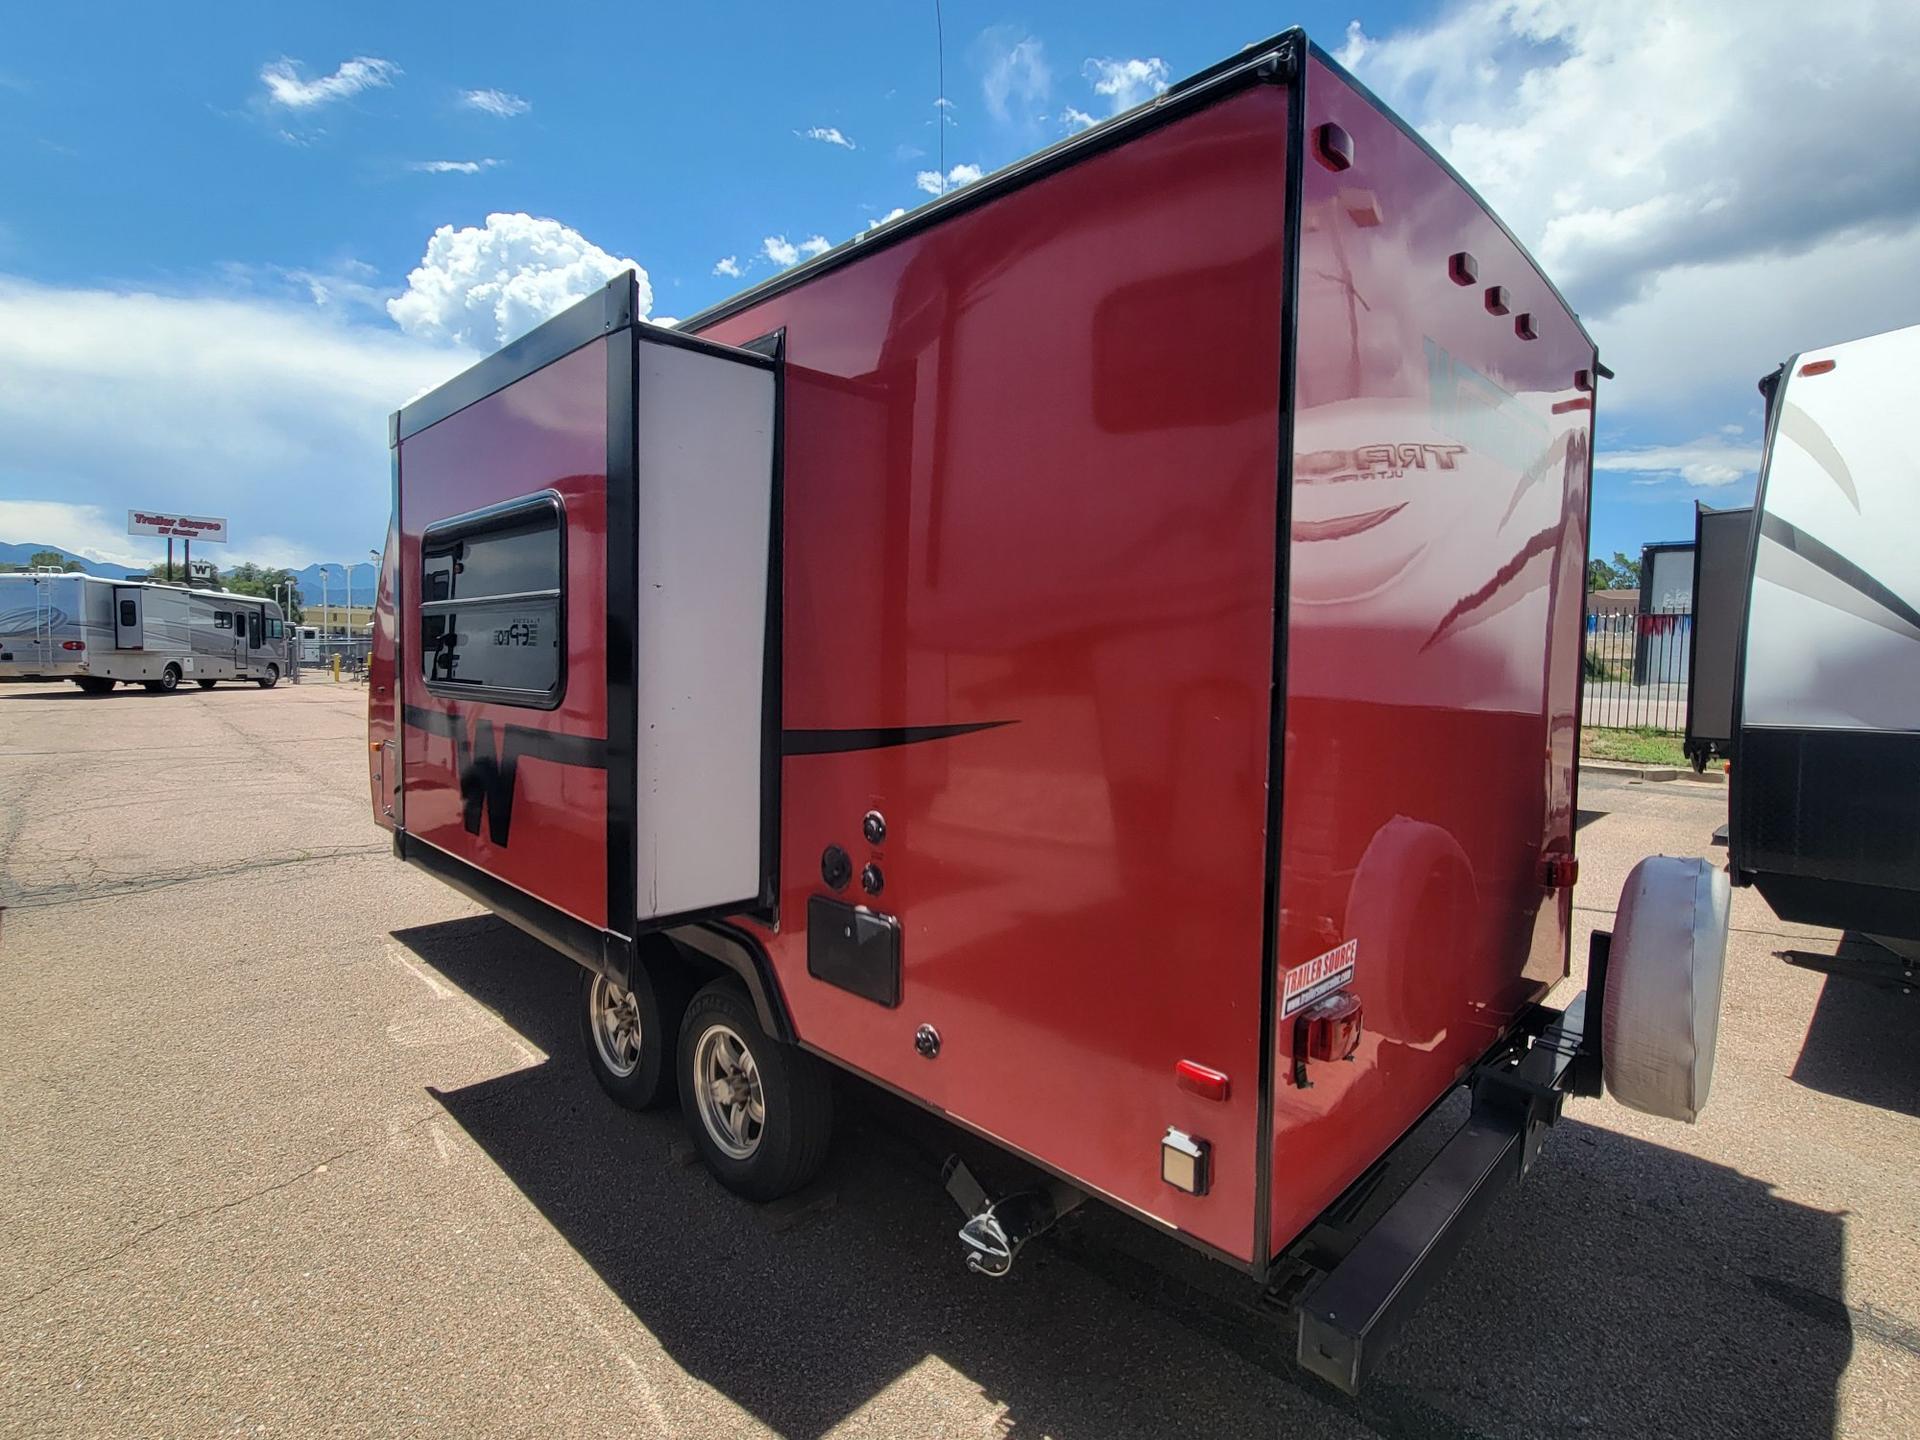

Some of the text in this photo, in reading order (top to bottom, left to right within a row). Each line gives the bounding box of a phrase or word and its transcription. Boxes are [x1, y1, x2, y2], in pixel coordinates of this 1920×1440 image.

[134, 513, 222, 531] Trailer Source
[191, 564, 210, 575] W
[1286, 941, 1356, 997] TRAILER SOURCE
